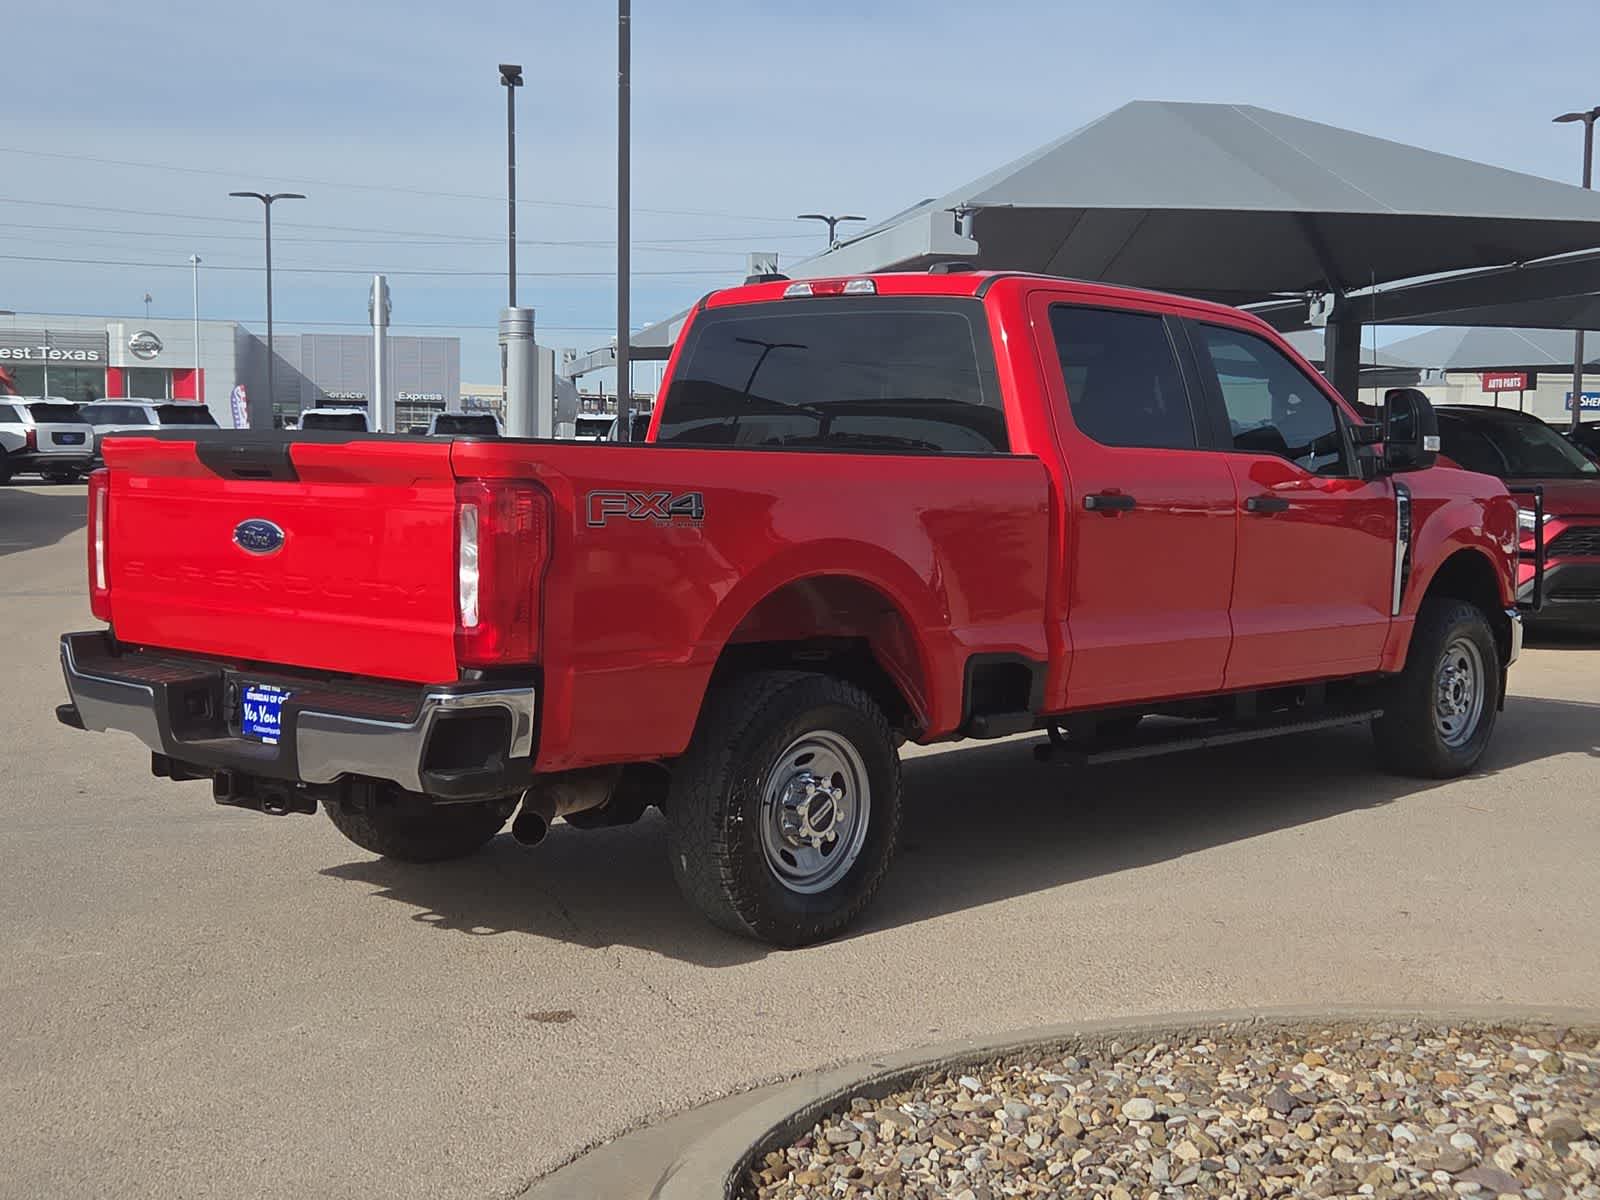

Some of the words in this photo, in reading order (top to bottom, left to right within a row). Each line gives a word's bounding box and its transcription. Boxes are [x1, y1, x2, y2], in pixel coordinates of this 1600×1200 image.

[0, 347, 31, 359] est
[37, 346, 99, 361] Texas
[1488, 379, 1503, 389] AUTO
[1503, 377, 1521, 388] PARTS
[398, 391, 443, 402] Express
[587, 490, 704, 528] FX4
[243, 703, 258, 722] Yes
